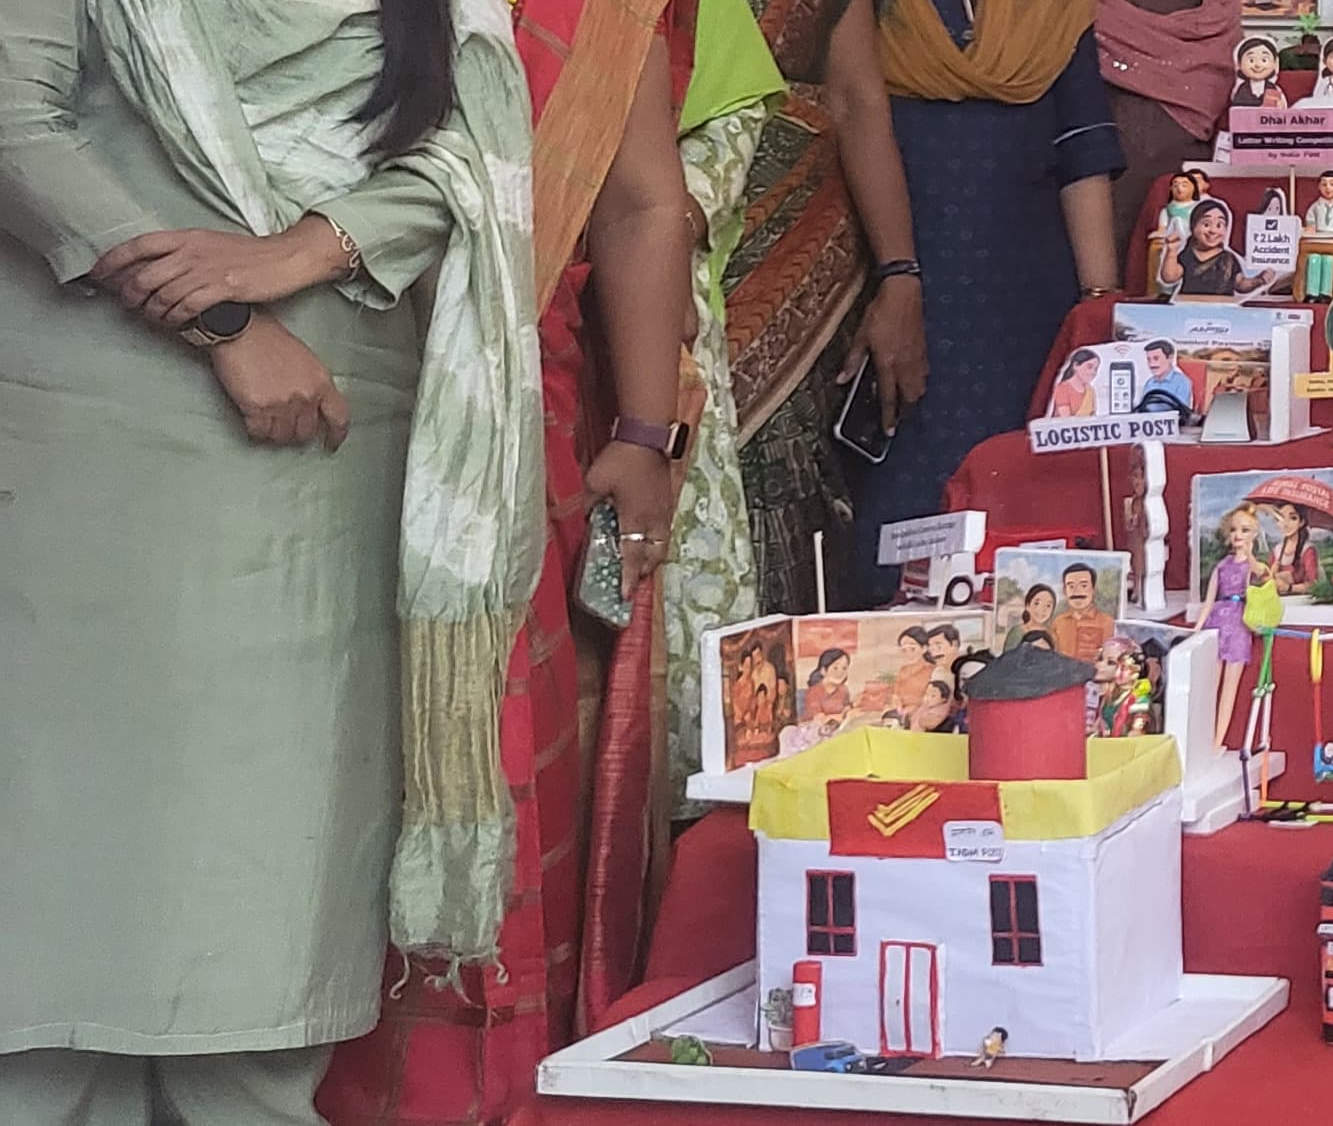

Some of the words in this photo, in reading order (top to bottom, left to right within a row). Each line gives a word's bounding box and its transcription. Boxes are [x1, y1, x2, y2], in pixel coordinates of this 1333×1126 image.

[1260, 115, 1287, 126] Dhai
[1290, 114, 1326, 125] Akhar
[1268, 233, 1290, 243] Lakh
[1253, 245, 1290, 254] Accident
[1034, 423, 1122, 448] LOGISTIC
[1127, 418, 1176, 438] POST
